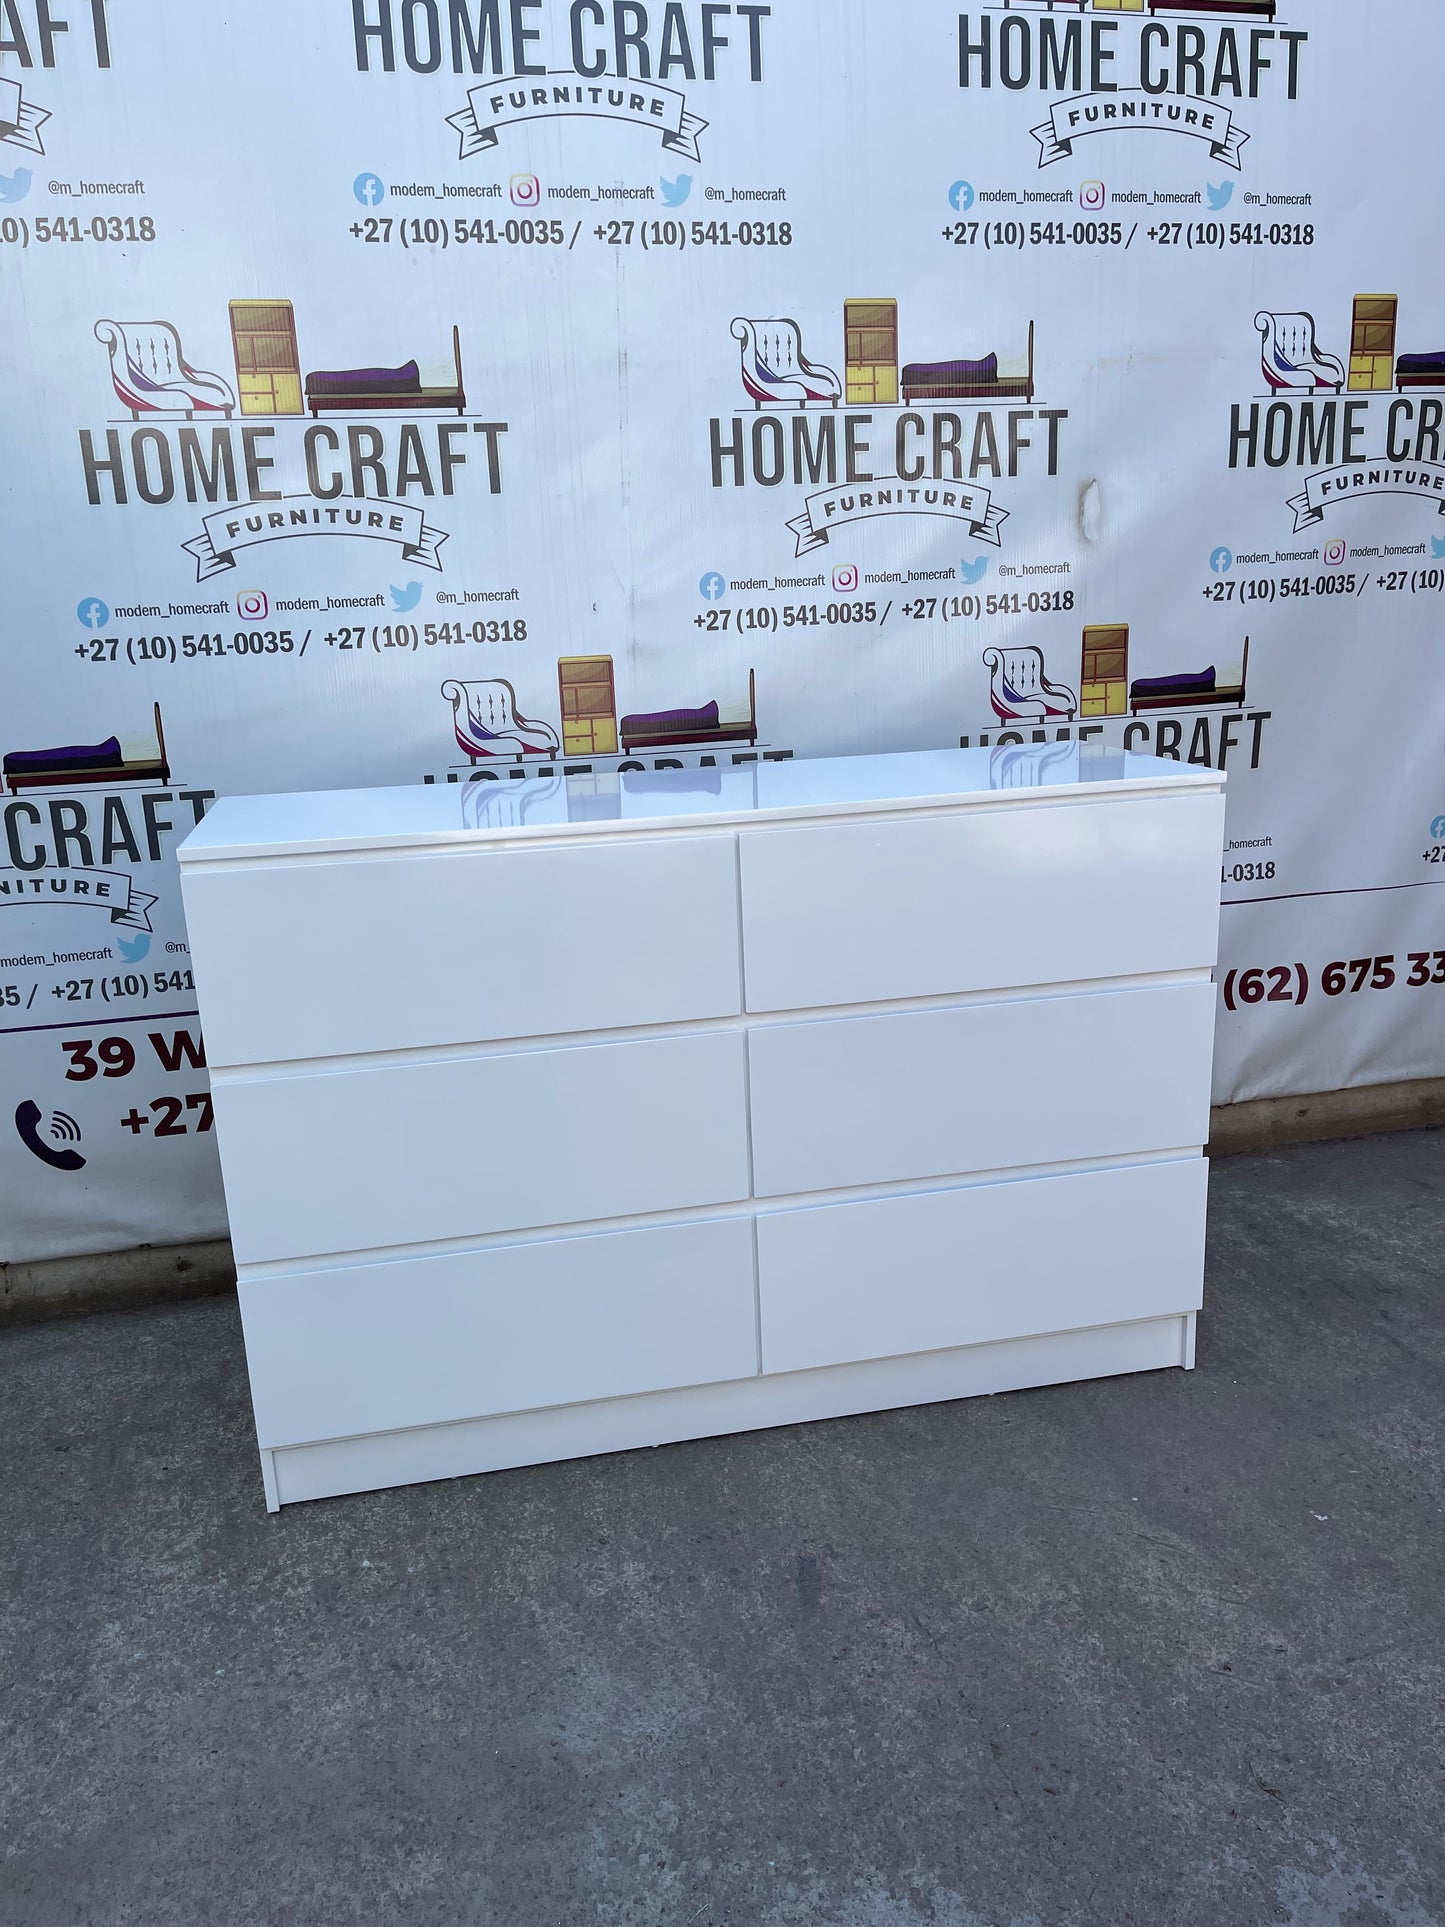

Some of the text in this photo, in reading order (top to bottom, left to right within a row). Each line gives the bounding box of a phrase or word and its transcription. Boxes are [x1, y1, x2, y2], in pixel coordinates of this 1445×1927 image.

[352, 0, 771, 82] HOME CRAFT
[959, 13, 1308, 100] HOME CRAFT
[490, 86, 666, 118] FURNITURE
[1068, 102, 1215, 130] FURNITURE
[48, 180, 145, 197] @m_homecraft
[705, 187, 786, 203] @m_homecraft
[1244, 192, 1311, 206] @m_homecraft
[35, 217, 155, 242] 541-0318
[350, 218, 393, 242] +27
[400, 219, 448, 249] (10)
[455, 219, 564, 244] 541-0035
[594, 221, 634, 244] +27
[641, 221, 685, 250] (10)
[692, 222, 792, 245] 541-0318
[942, 222, 979, 244] +27
[985, 222, 1024, 249] (10)
[1030, 222, 1121, 244] 541-0035
[1147, 223, 1182, 244] +27
[1187, 223, 1224, 249] (10)
[1230, 223, 1314, 245] 541-0318
[710, 409, 1068, 489] HOME CRAFT
[1229, 401, 1369, 469] HOME
[79, 423, 508, 506] HOME CRAFT
[1320, 469, 1444, 496] FURNITURE
[823, 488, 973, 517] FURNITURE
[225, 508, 403, 539] FURNITURE
[999, 562, 1070, 577] @m_homecraft
[436, 588, 519, 605] @m_homecraft
[1203, 582, 1235, 601] +27
[1240, 579, 1275, 604] (10)
[1280, 574, 1355, 597] 541-0035
[1377, 571, 1407, 590] +27
[1411, 569, 1444, 593] (10)
[694, 610, 731, 631] +27
[737, 607, 777, 634] (10)
[783, 602, 876, 626] 541-0035
[902, 598, 937, 619] +27
[942, 596, 981, 622] (10)
[986, 590, 1074, 614] 541-0318
[75, 639, 119, 661] +27
[127, 636, 176, 665] (10)
[182, 631, 294, 657] 541-0035
[324, 627, 365, 649] +27
[373, 625, 418, 653] (10)
[424, 620, 527, 645] 541-0318
[3, 788, 215, 872] CRAFT
[52, 979, 93, 1001] +27
[101, 975, 148, 1002] (10)
[1224, 963, 1308, 1011] (62)
[1322, 955, 1395, 996] 675
[62, 1037, 135, 1081] 39
